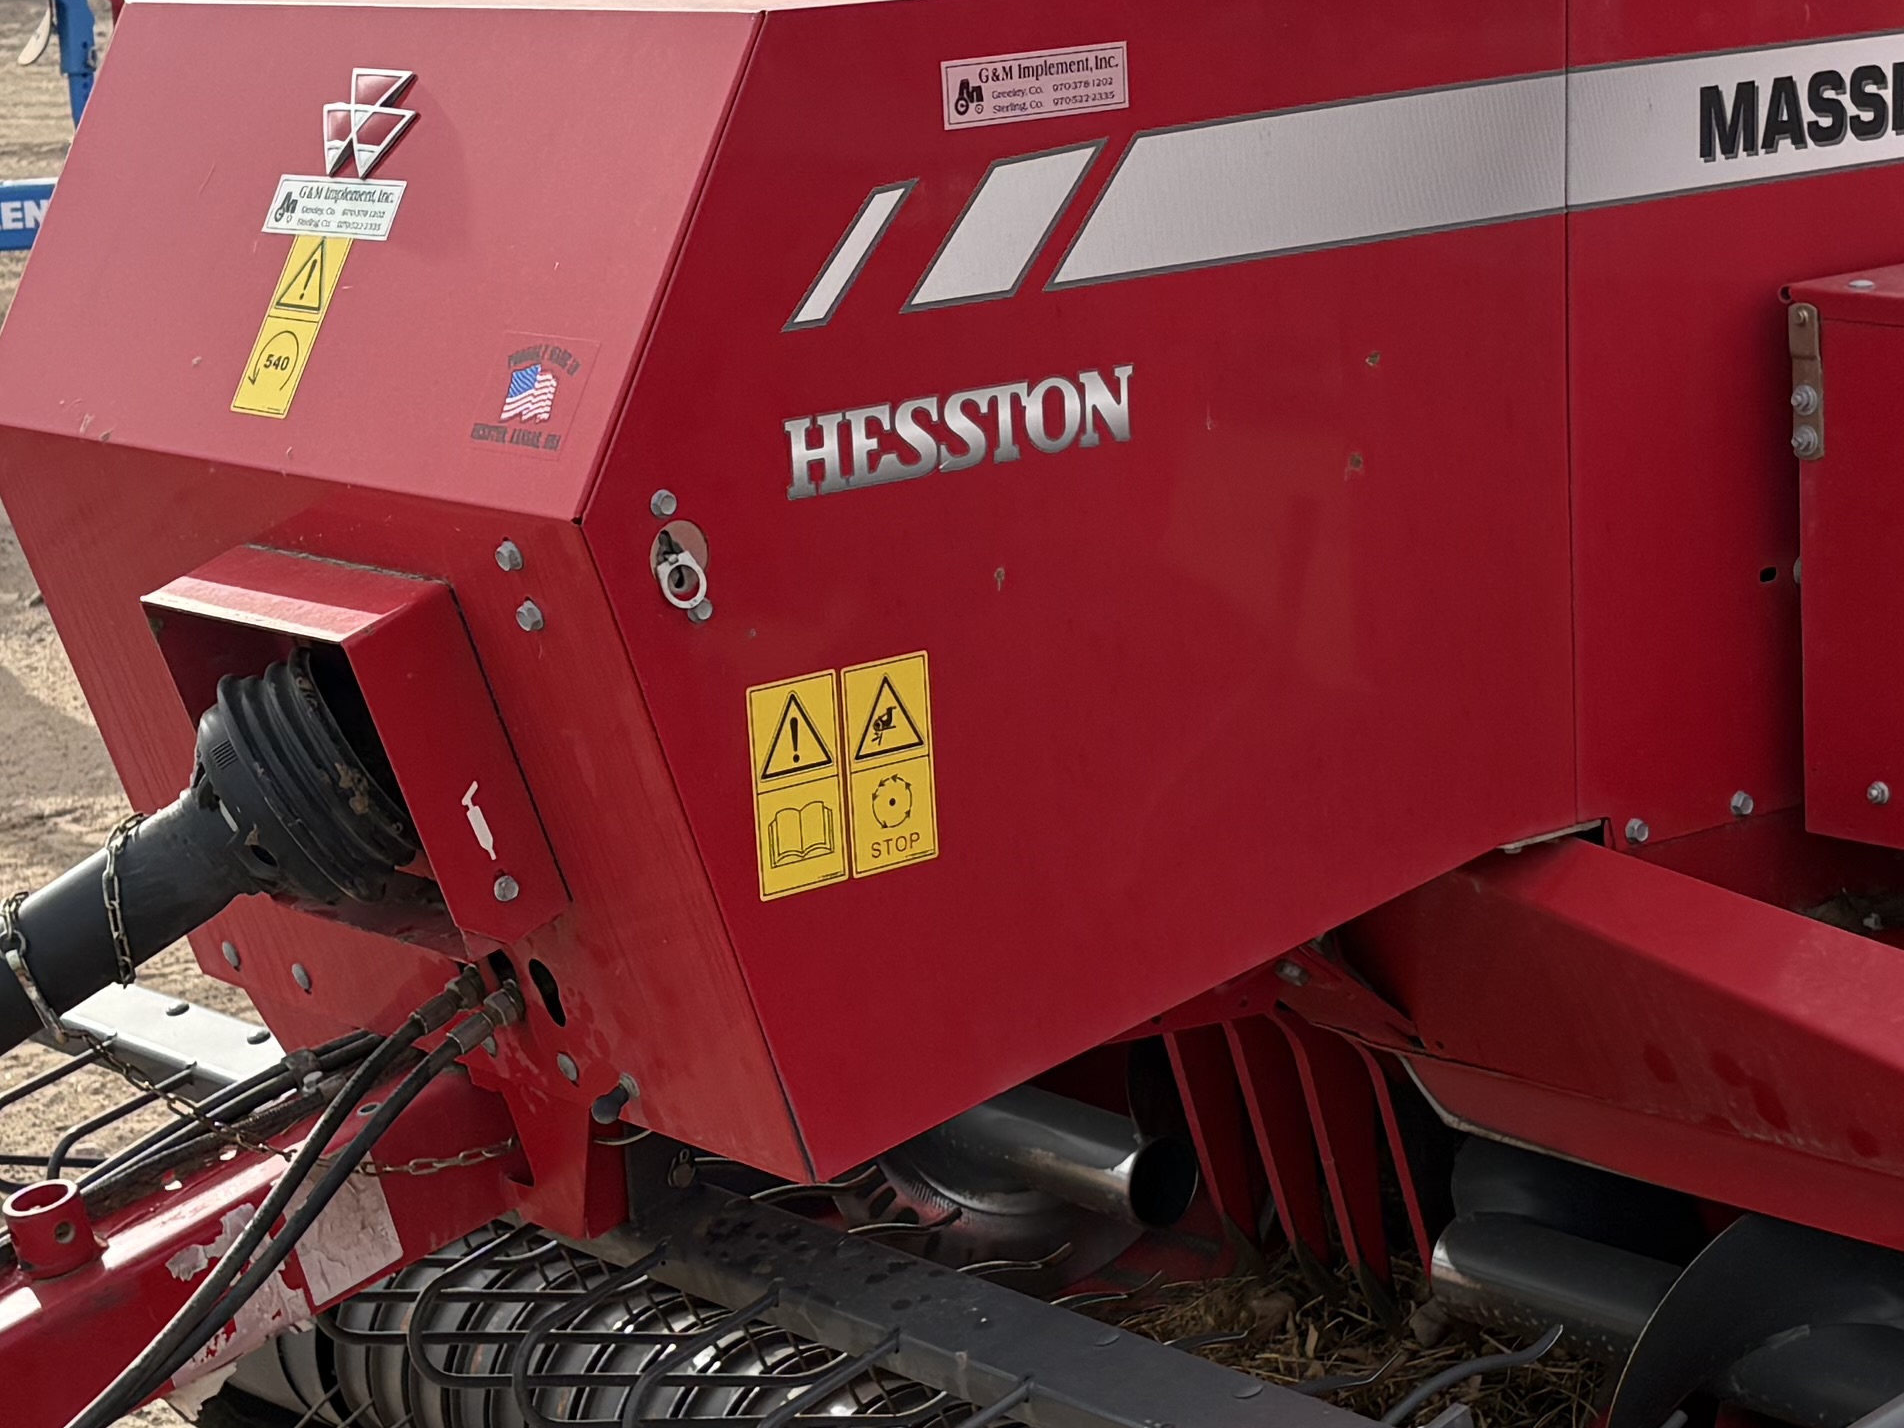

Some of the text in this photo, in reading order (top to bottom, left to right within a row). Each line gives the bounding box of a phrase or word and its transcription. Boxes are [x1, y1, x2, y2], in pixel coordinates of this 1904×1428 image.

[978, 65, 1013, 83] G&M
[1018, 57, 1093, 81] Implement,
[263, 354, 290, 371] 540
[781, 363, 1135, 501] HESSTON
[871, 831, 921, 859] STOP
